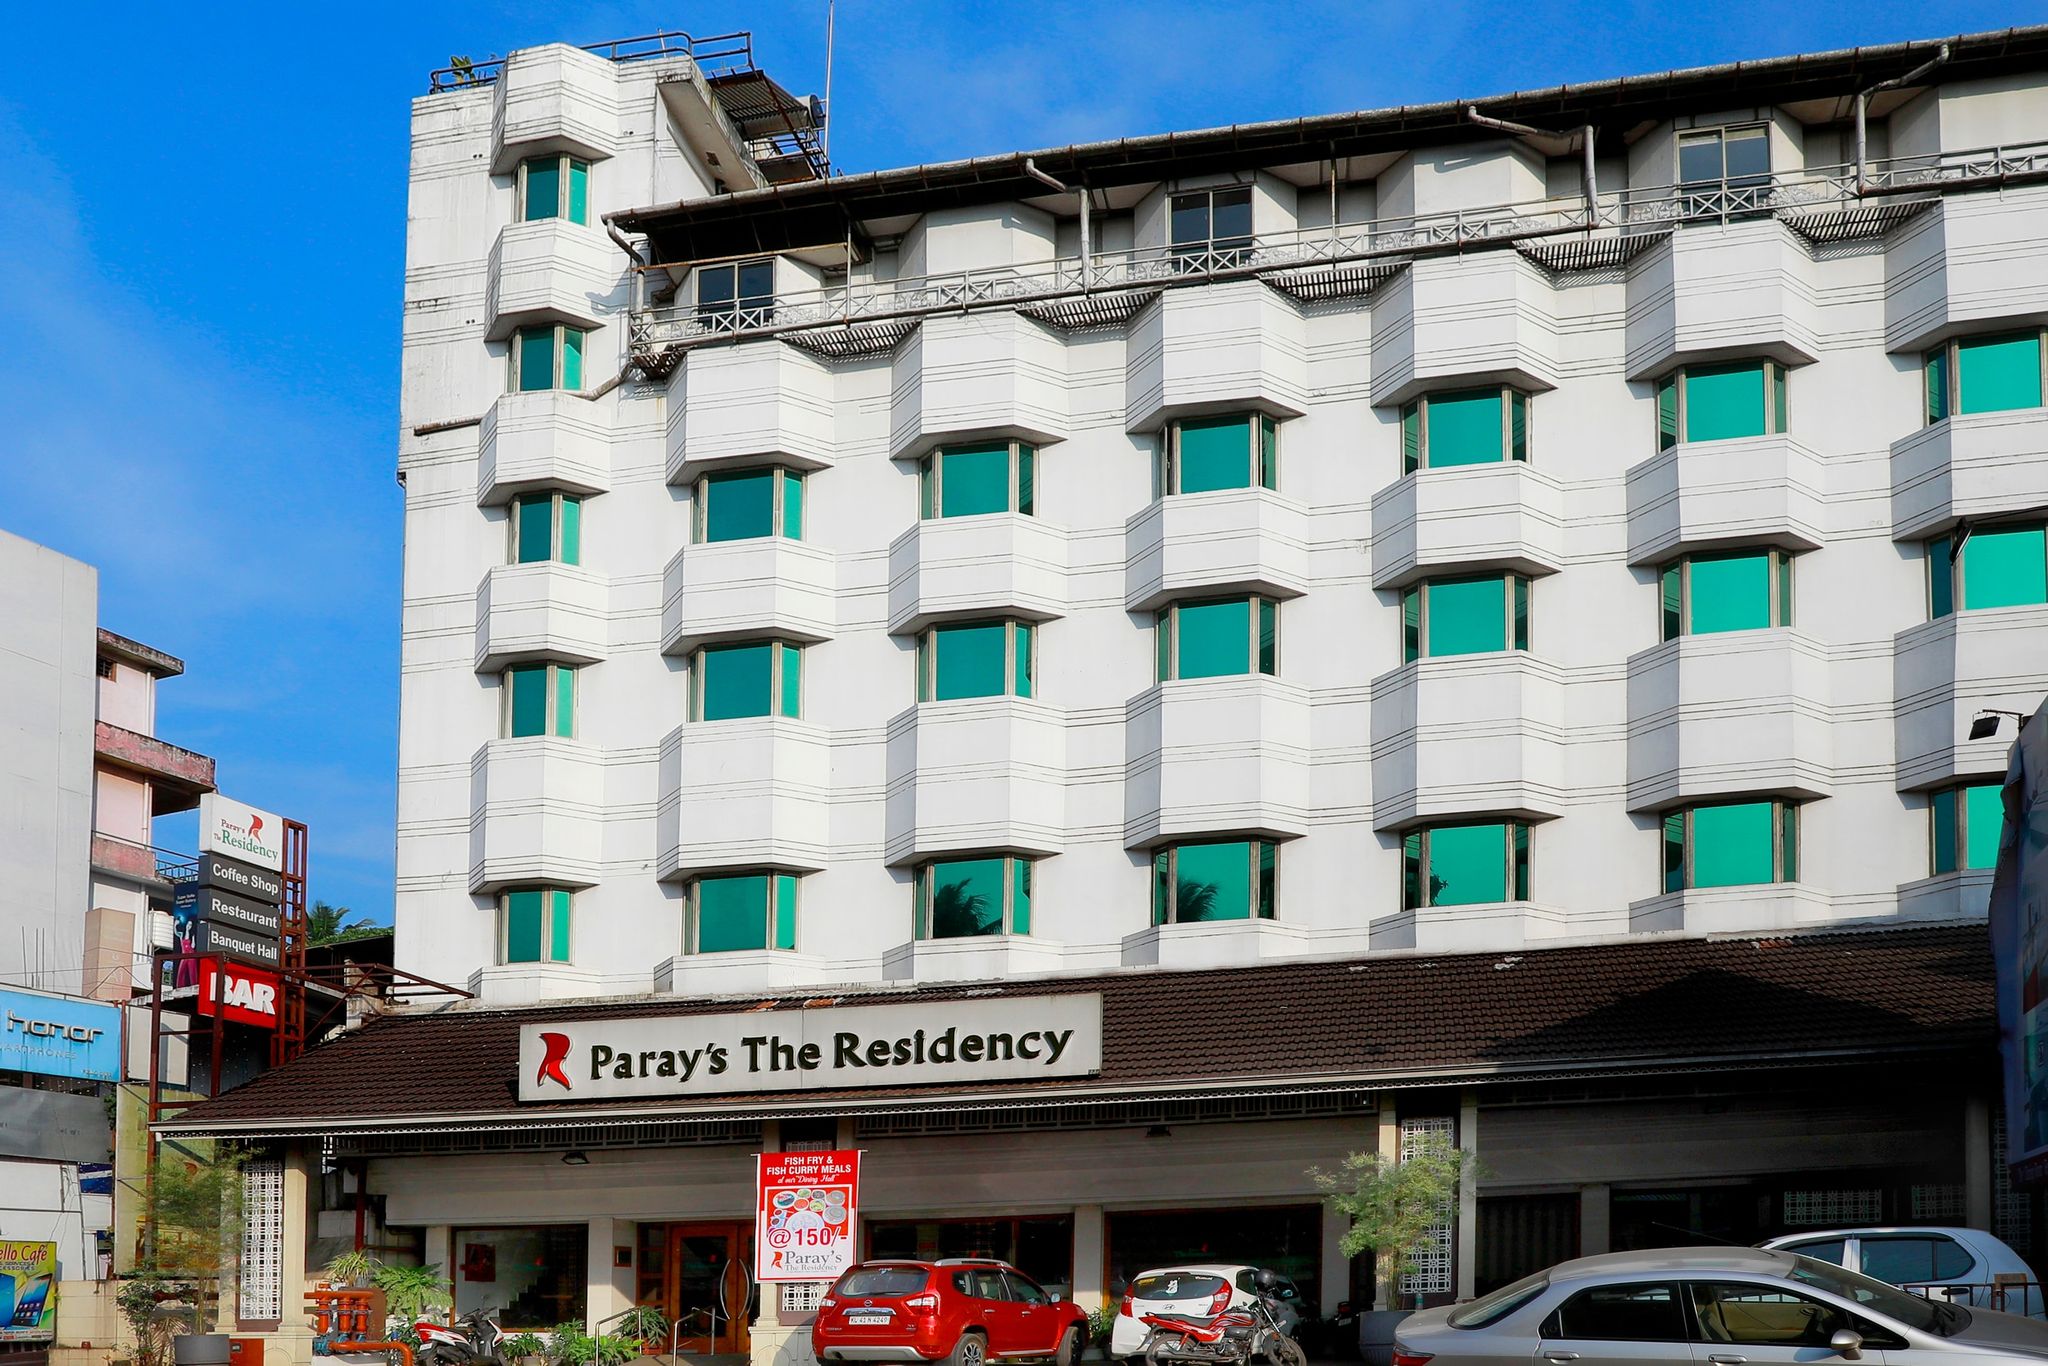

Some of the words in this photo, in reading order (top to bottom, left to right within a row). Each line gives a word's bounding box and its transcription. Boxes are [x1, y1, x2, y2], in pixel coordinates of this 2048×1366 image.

[221, 828, 279, 862] Residency
[212, 863, 248, 885] Coffee
[250, 874, 279, 896] Shop
[211, 897, 278, 929] Restaurant
[210, 930, 255, 954] Banquet
[257, 943, 277, 960] Hall
[209, 972, 276, 1015] BAR
[7, 1009, 104, 1043] honor
[590, 1042, 730, 1083] Paray's
[740, 1035, 822, 1073] The
[832, 1026, 1075, 1069] Residency
[766, 1166, 786, 1176] FISH
[788, 1165, 819, 1175] CURRY
[821, 1164, 852, 1174] MEALS
[784, 1156, 805, 1165] FISH
[807, 1155, 824, 1164] FRY
[826, 1155, 834, 1164] &
[785, 1250, 842, 1267] Paray's
